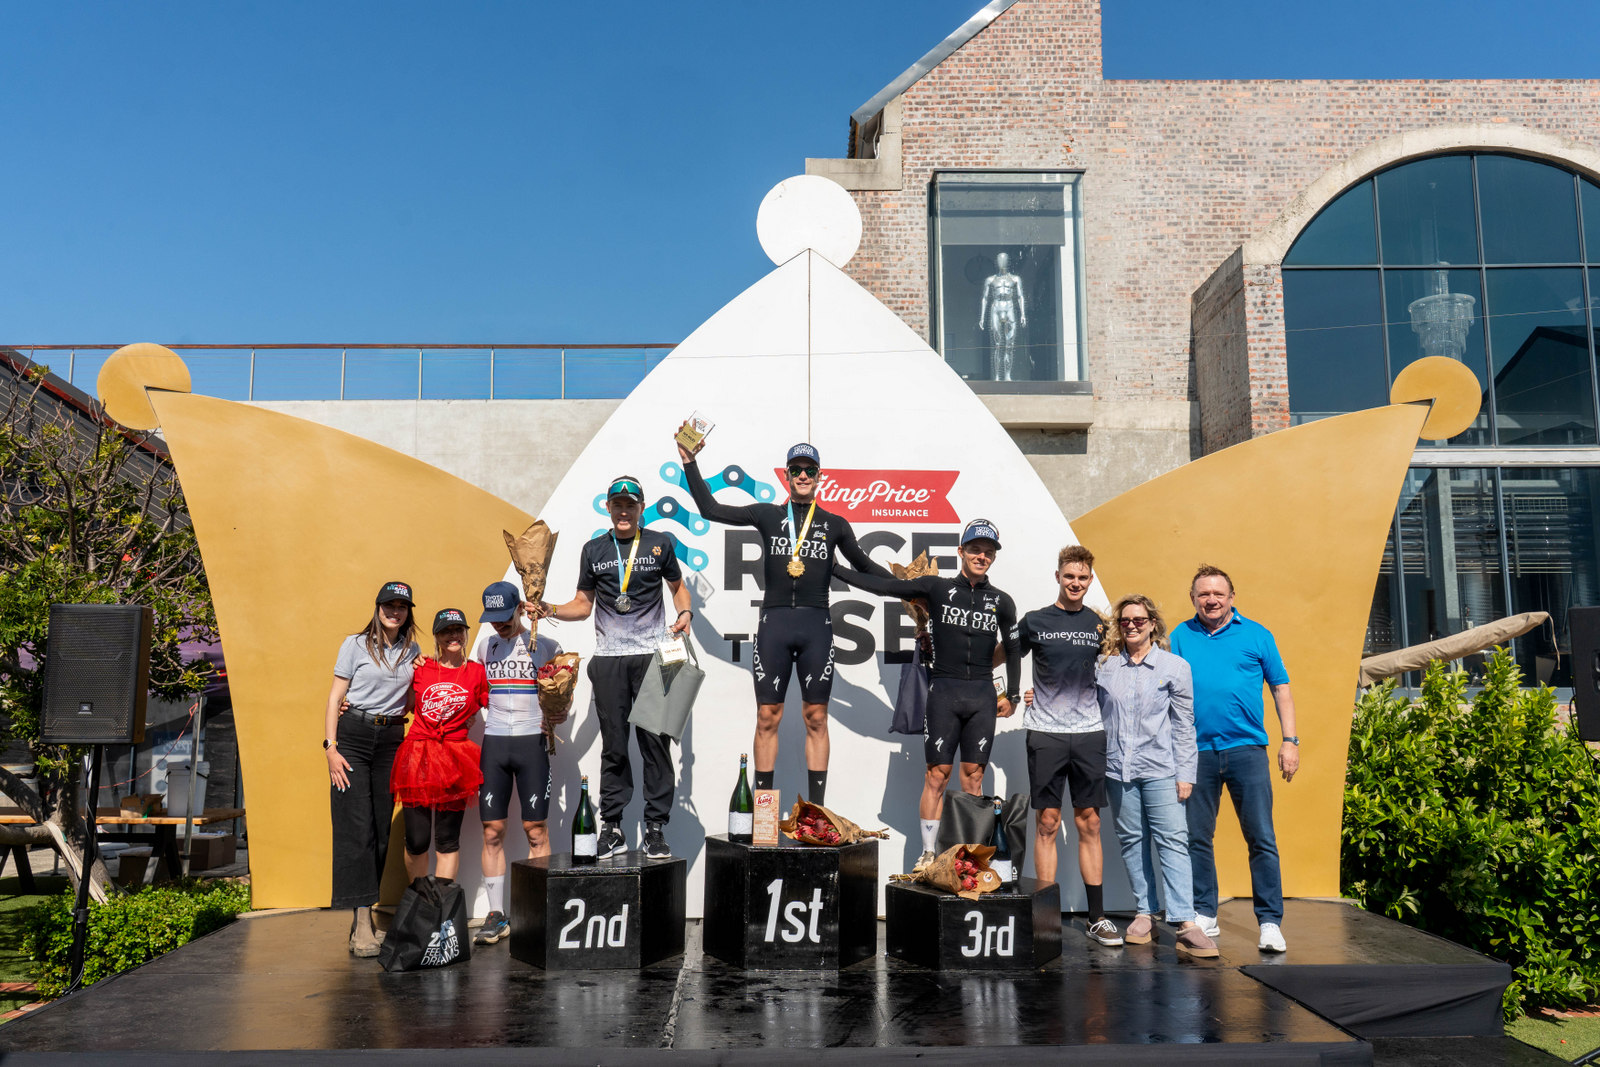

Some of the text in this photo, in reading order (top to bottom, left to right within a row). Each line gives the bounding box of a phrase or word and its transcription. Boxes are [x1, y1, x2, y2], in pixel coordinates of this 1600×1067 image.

[871, 508, 929, 518] INSURANCE
[723, 529, 960, 591] RCE
[941, 604, 998, 624] TOYOTA
[941, 615, 998, 632] IMBUKO
[1037, 630, 1100, 642] Honeycomb
[488, 670, 539, 679] MBUKO
[764, 878, 824, 944] 1st
[558, 898, 629, 949] 2nd
[961, 910, 1015, 958] 3rd
